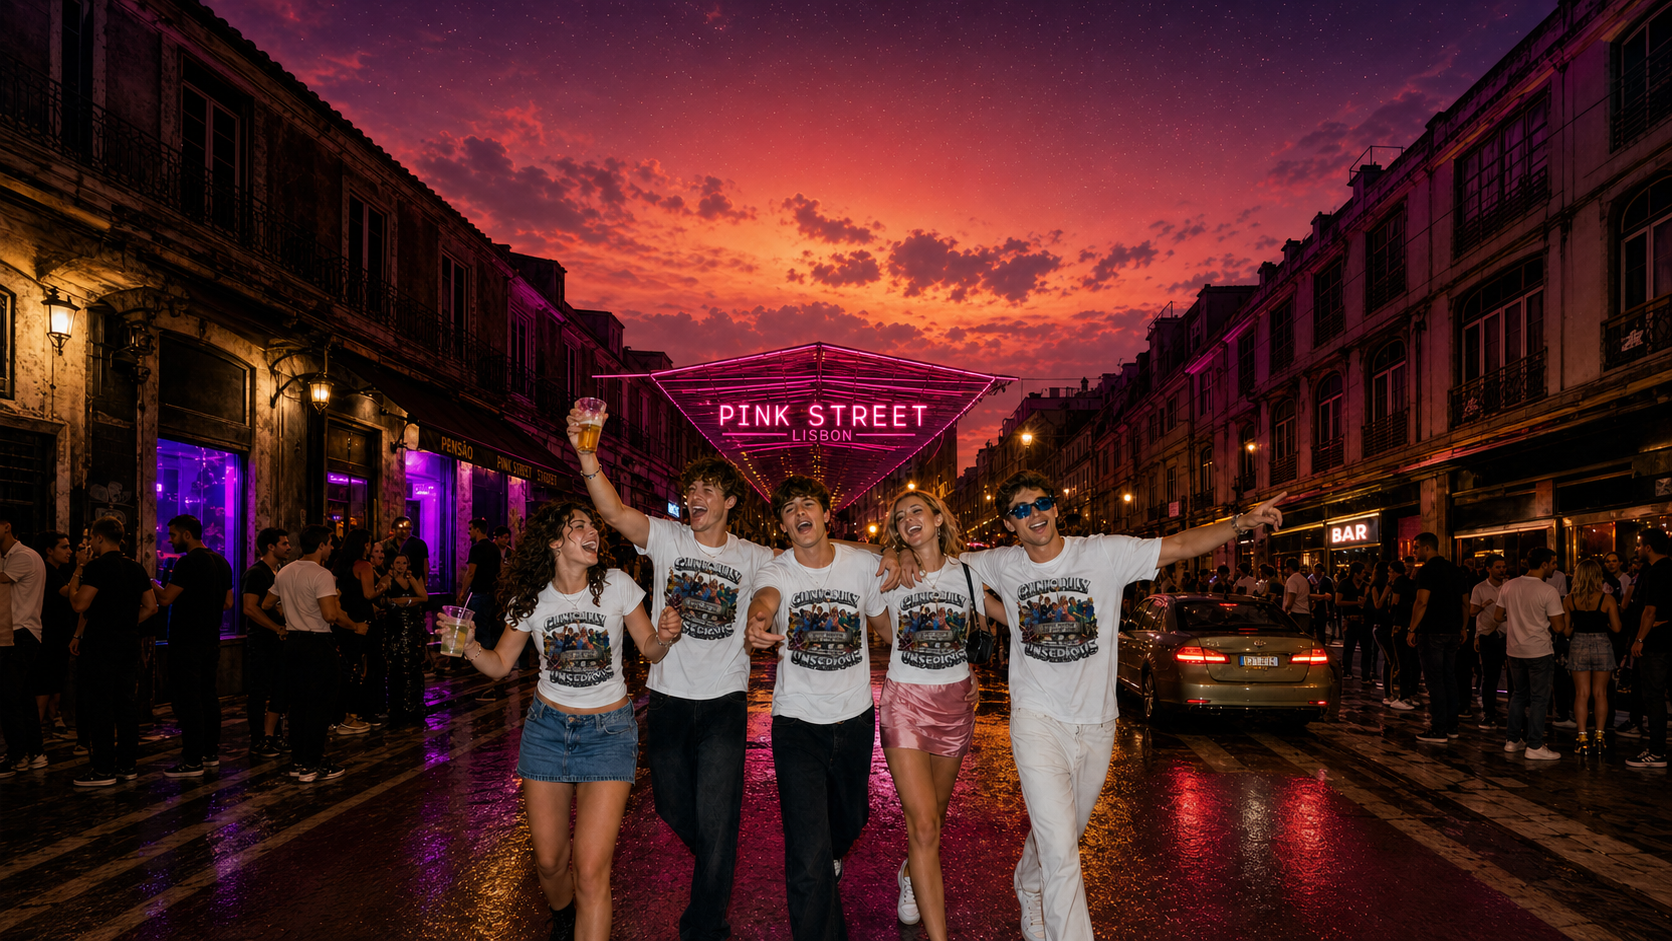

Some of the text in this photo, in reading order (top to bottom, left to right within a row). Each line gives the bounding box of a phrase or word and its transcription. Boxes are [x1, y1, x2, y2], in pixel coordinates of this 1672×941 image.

[719, 404, 928, 427] PINK STREET
[792, 429, 853, 442] LISBON
[1331, 524, 1367, 543] BAR
